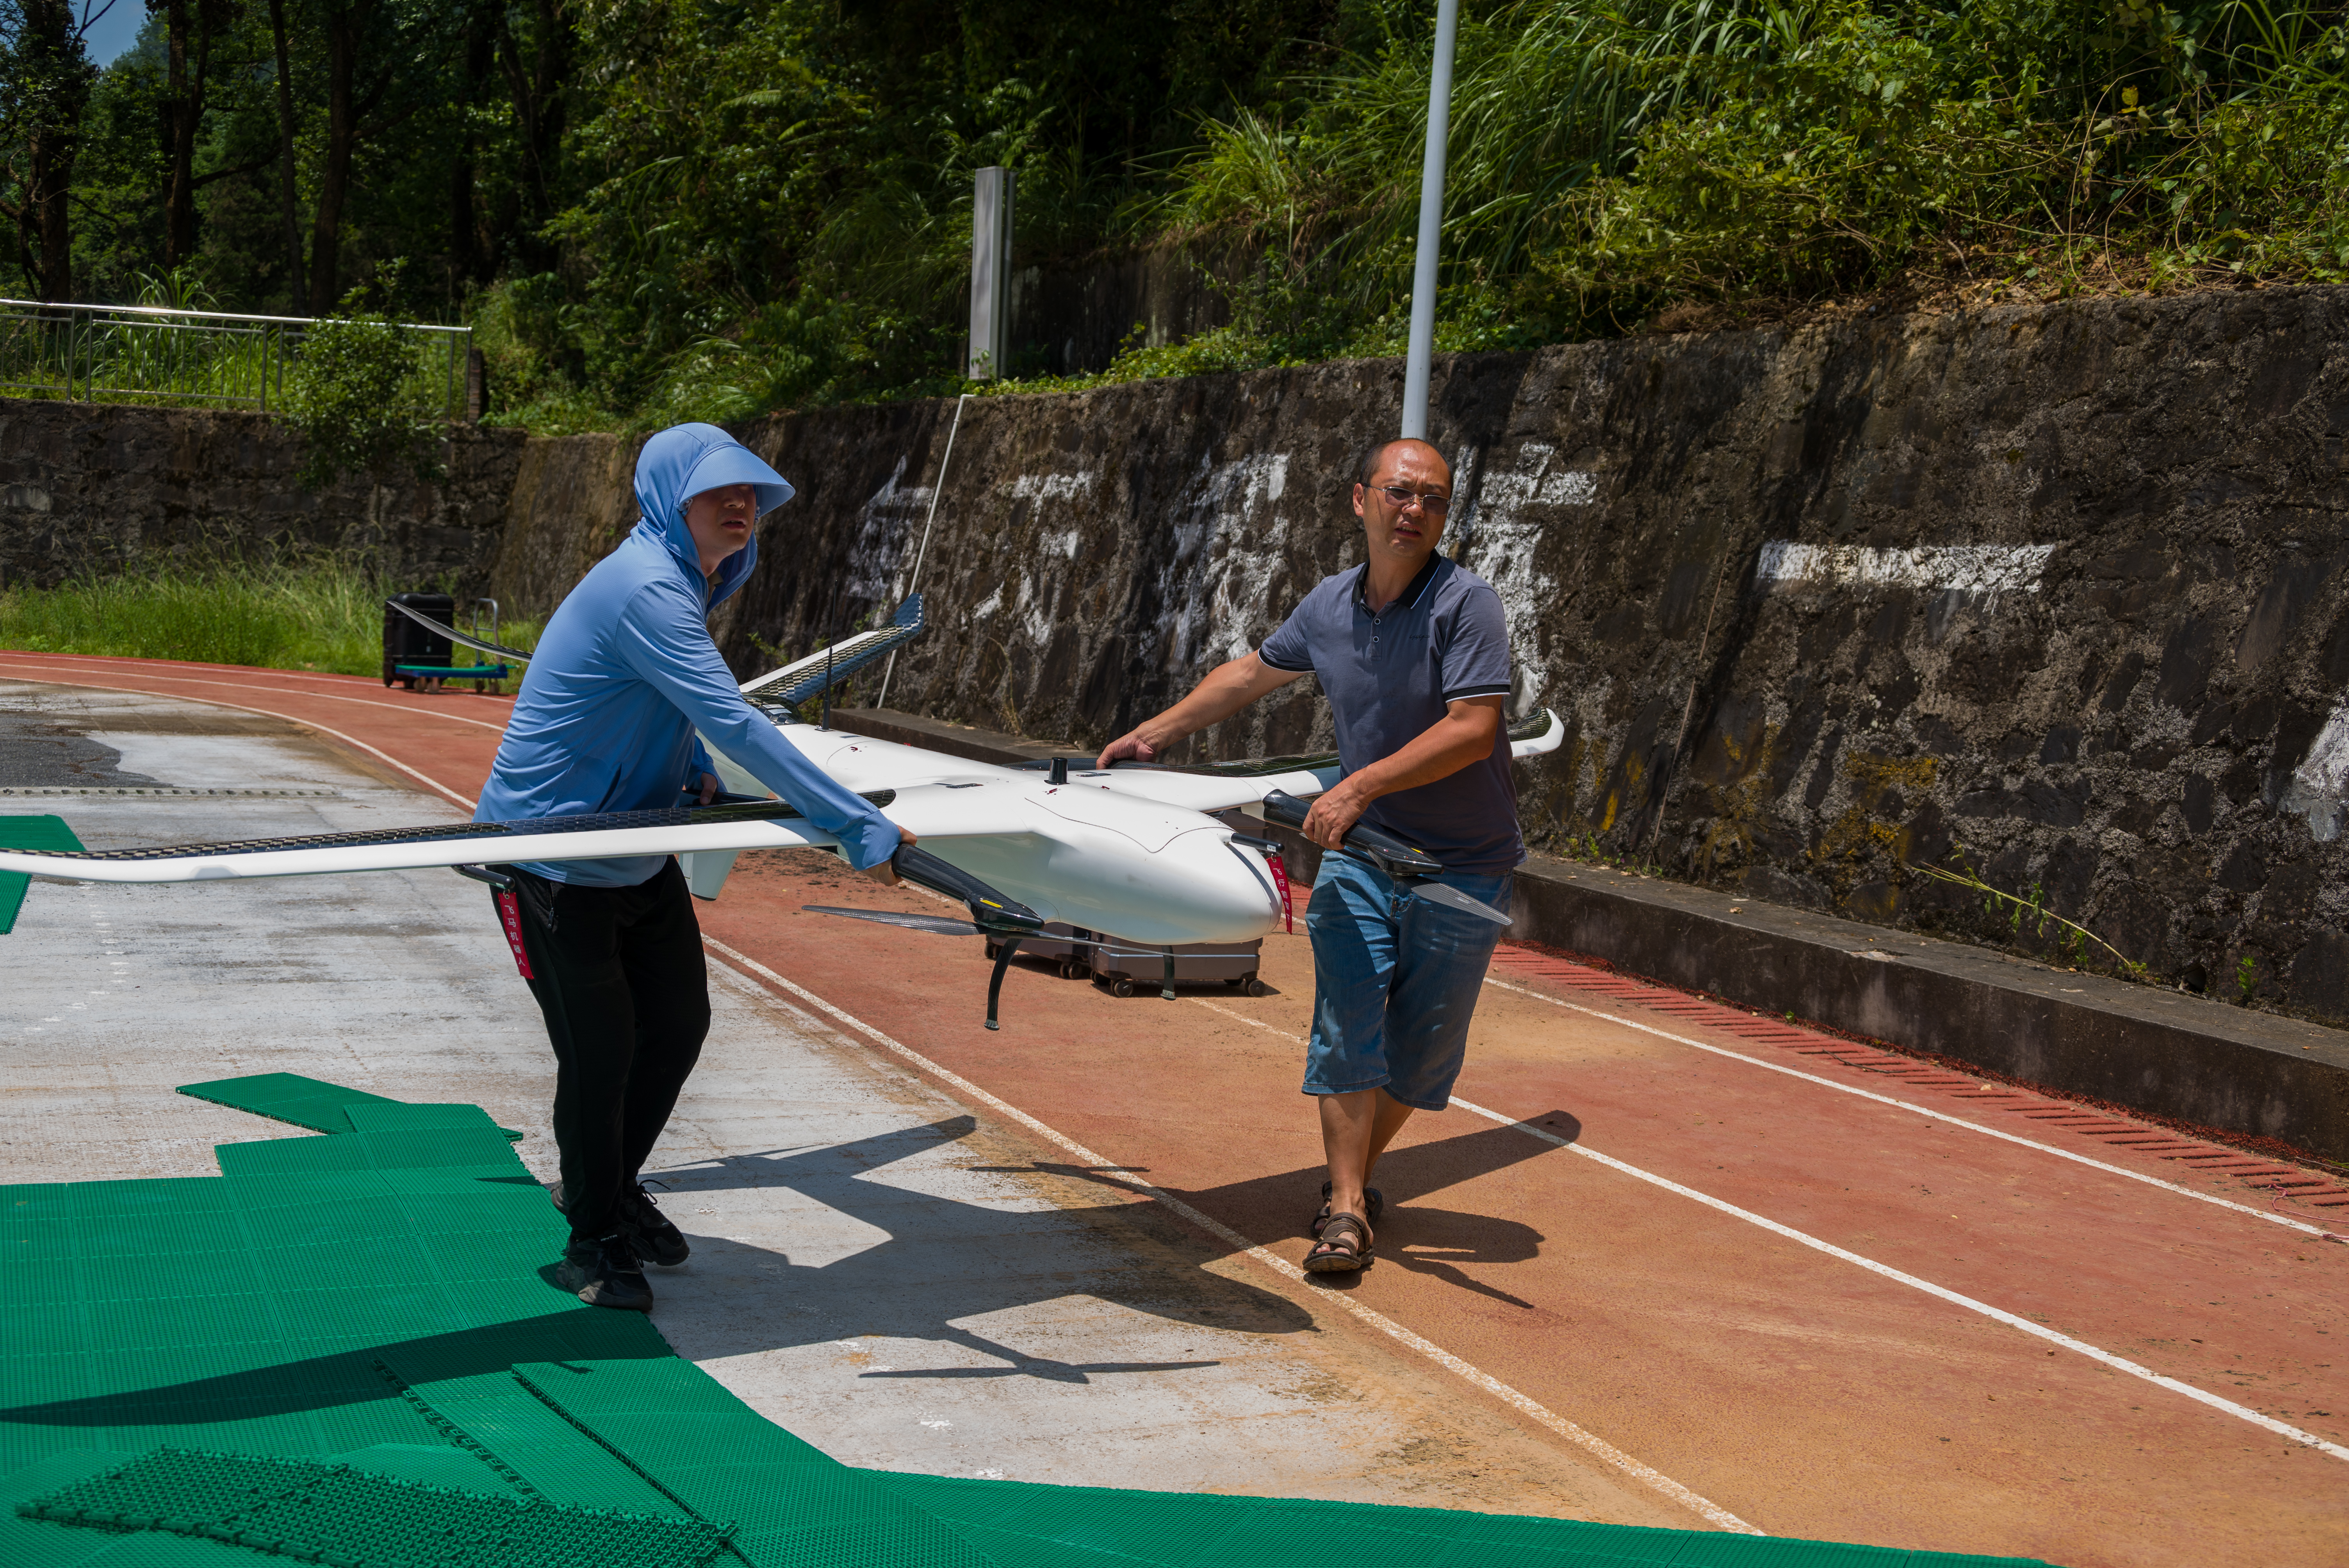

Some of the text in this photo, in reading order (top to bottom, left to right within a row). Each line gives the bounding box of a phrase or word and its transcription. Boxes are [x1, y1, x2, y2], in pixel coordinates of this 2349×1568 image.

[1273, 868, 1290, 922] 飞行前取下
[504, 905, 526, 966] 飞马机器人
